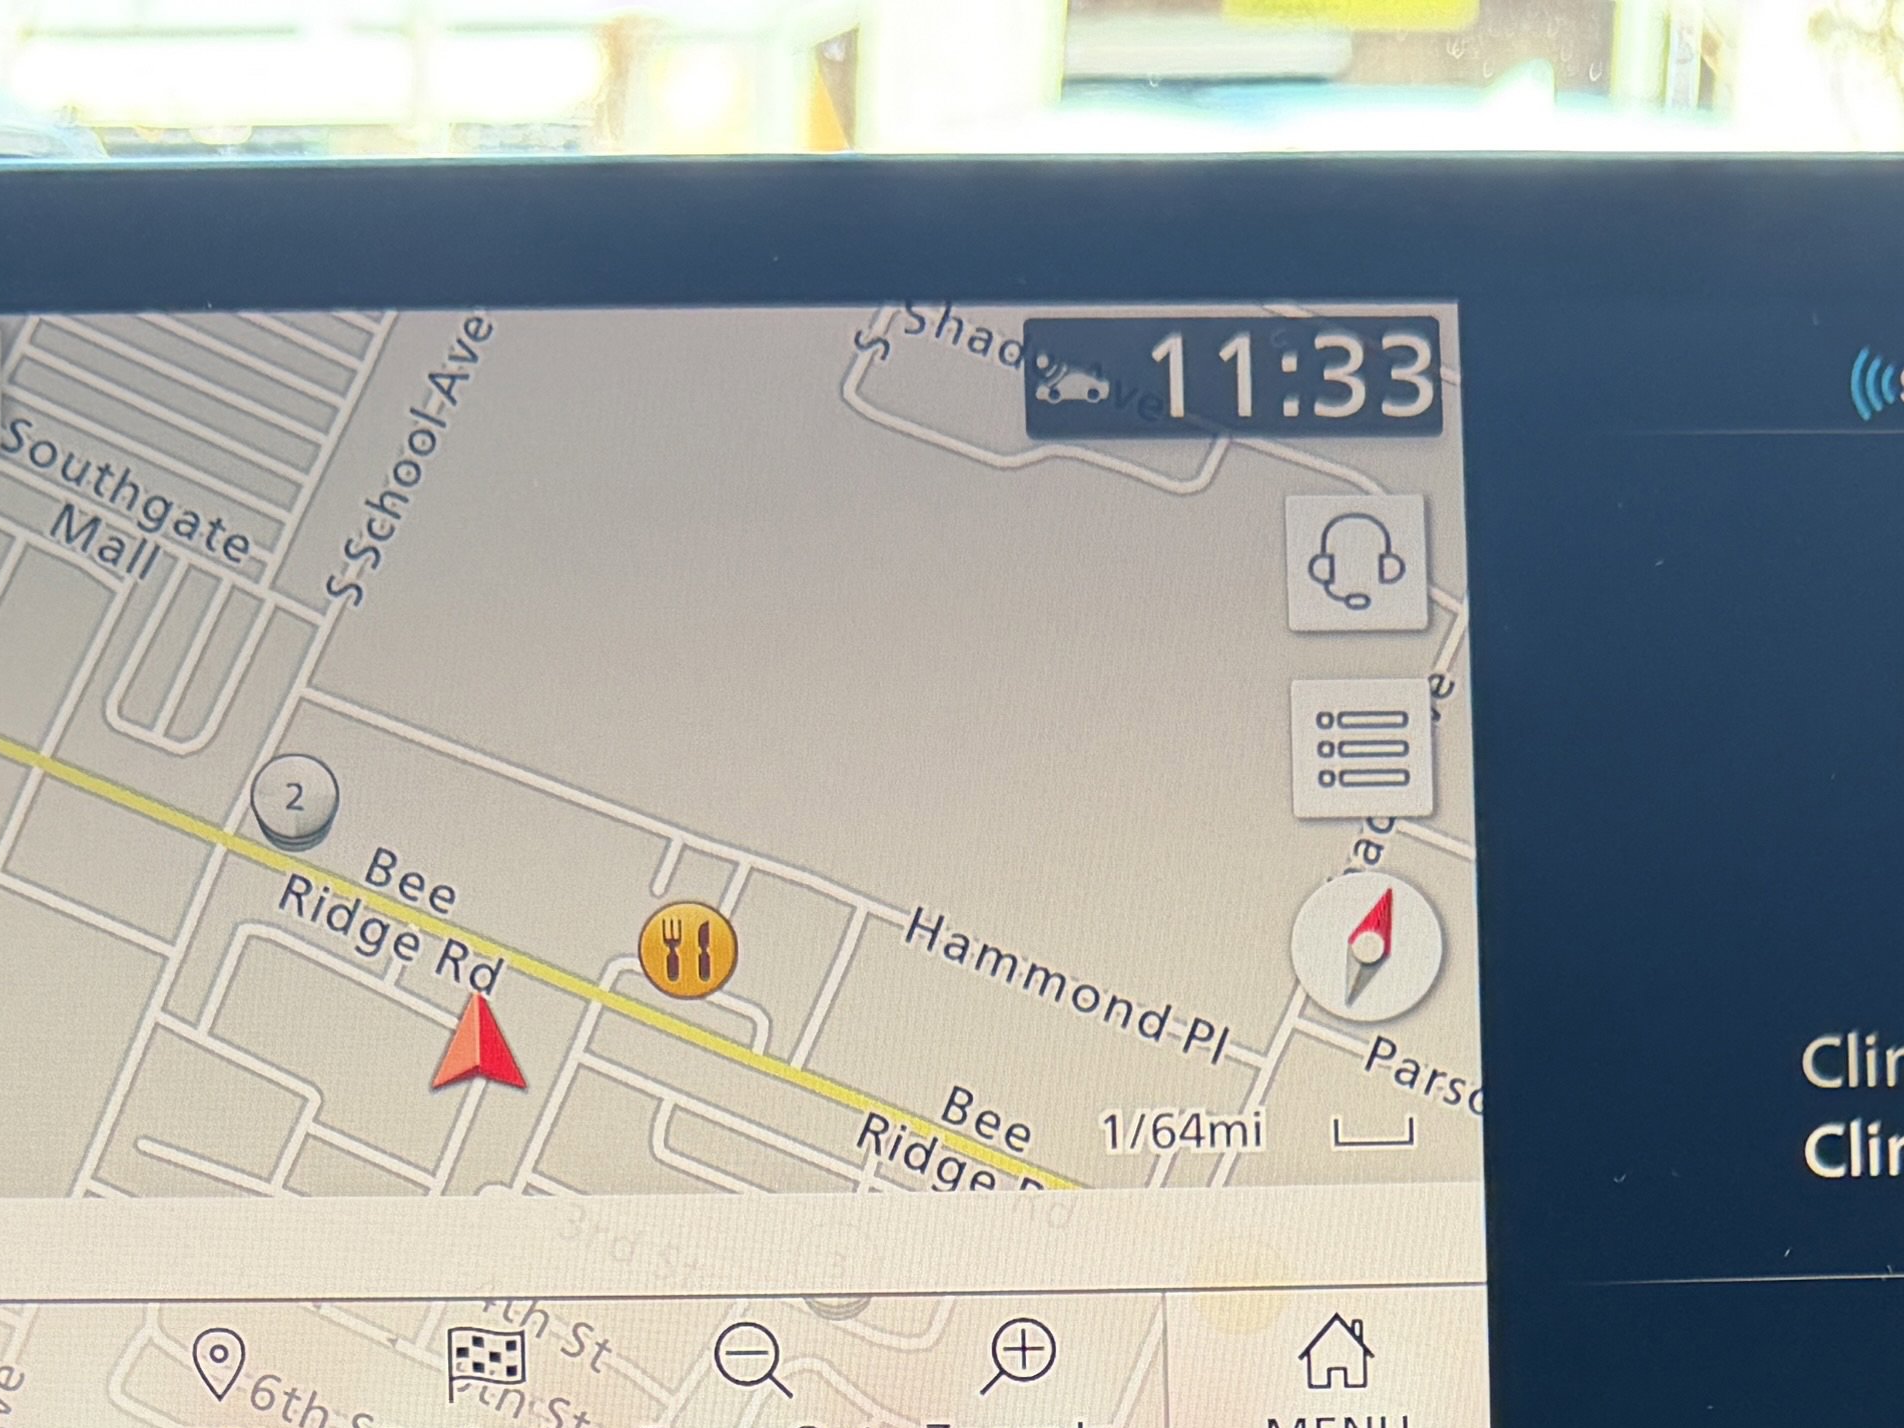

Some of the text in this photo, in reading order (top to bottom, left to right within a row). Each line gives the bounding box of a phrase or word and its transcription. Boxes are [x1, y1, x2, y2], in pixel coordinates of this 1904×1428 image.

[1150, 329, 1436, 420] 11:33
[0, 416, 252, 566] Southgate
[324, 312, 496, 609] S School Ave
[48, 501, 162, 582] Mall
[283, 781, 306, 813] 2
[363, 845, 458, 916] Bee
[276, 872, 505, 997] Ridge Rd
[902, 905, 1230, 1066] Hammond Pl
[856, 1111, 997, 1192] Ridge
[940, 1084, 1032, 1153] Bee
[1102, 1109, 1266, 1151] 1/64mi
[559, 1320, 614, 1374] St
